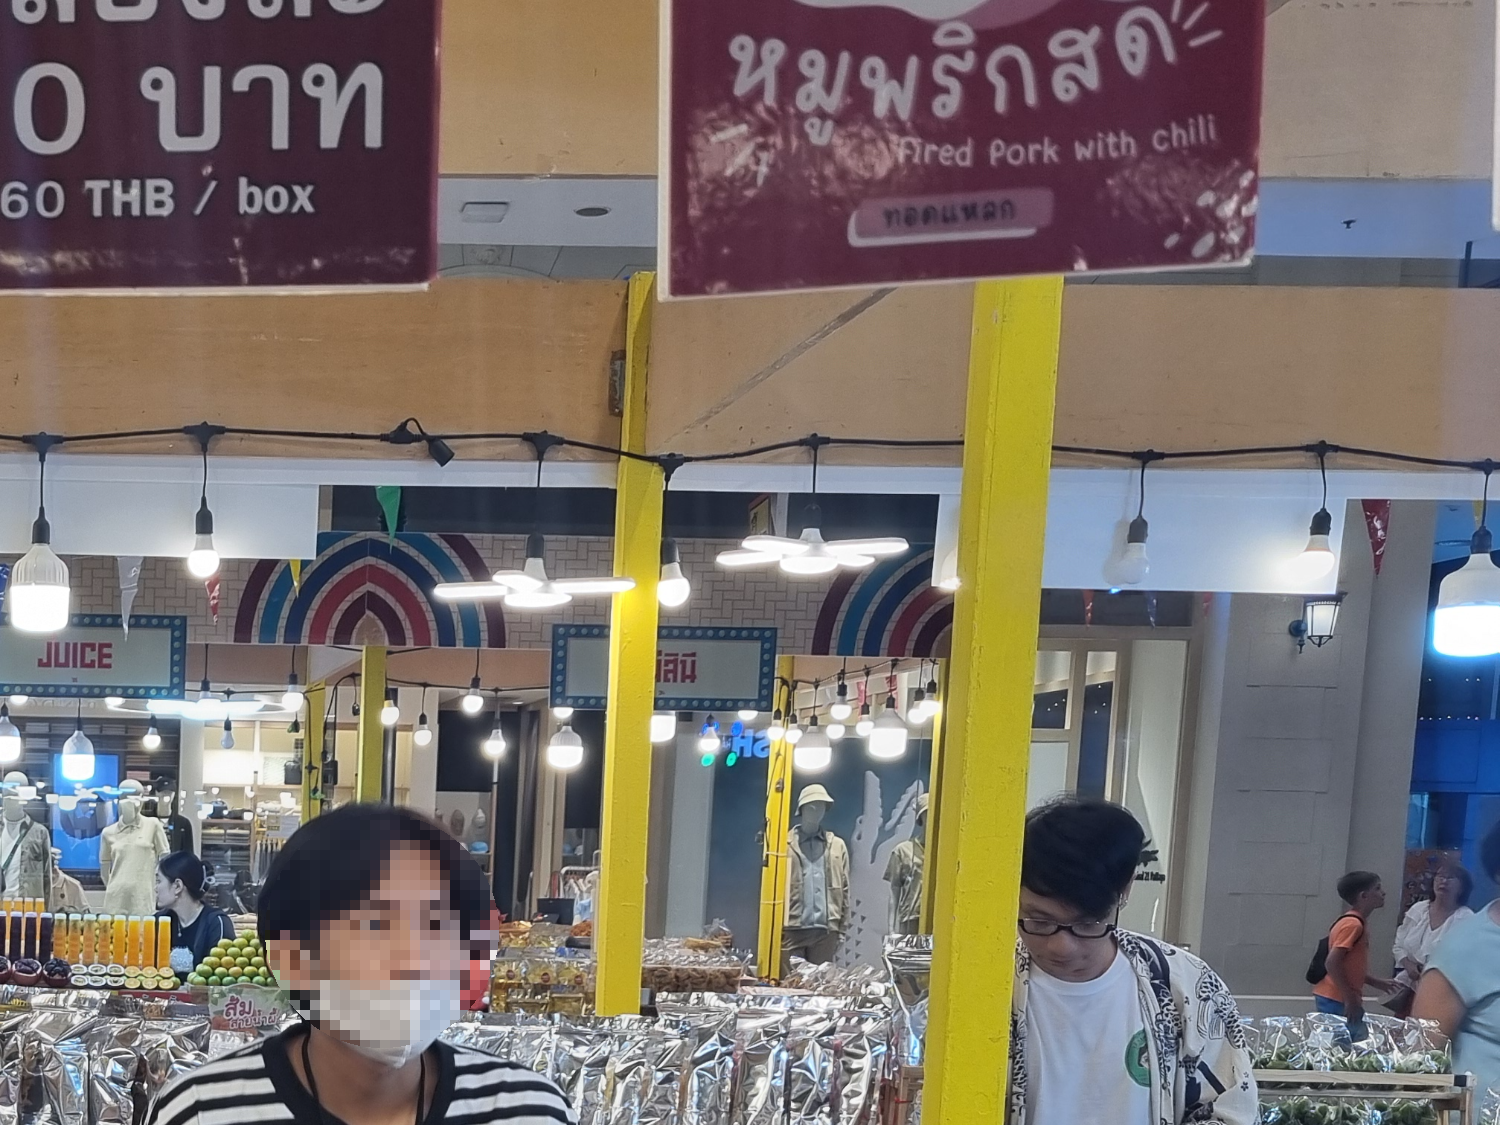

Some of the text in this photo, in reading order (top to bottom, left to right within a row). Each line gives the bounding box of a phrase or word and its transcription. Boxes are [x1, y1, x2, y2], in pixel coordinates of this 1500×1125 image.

[728, 5, 1177, 146] หมูพริกสด
[139, 62, 383, 152] บาท
[989, 136, 1060, 166] Pork
[1074, 130, 1137, 163] with
[1152, 114, 1217, 152] chili
[0, 177, 315, 218] 60 THB / box
[37, 641, 113, 669] JUICE
[225, 995, 253, 1018] ส้ม
